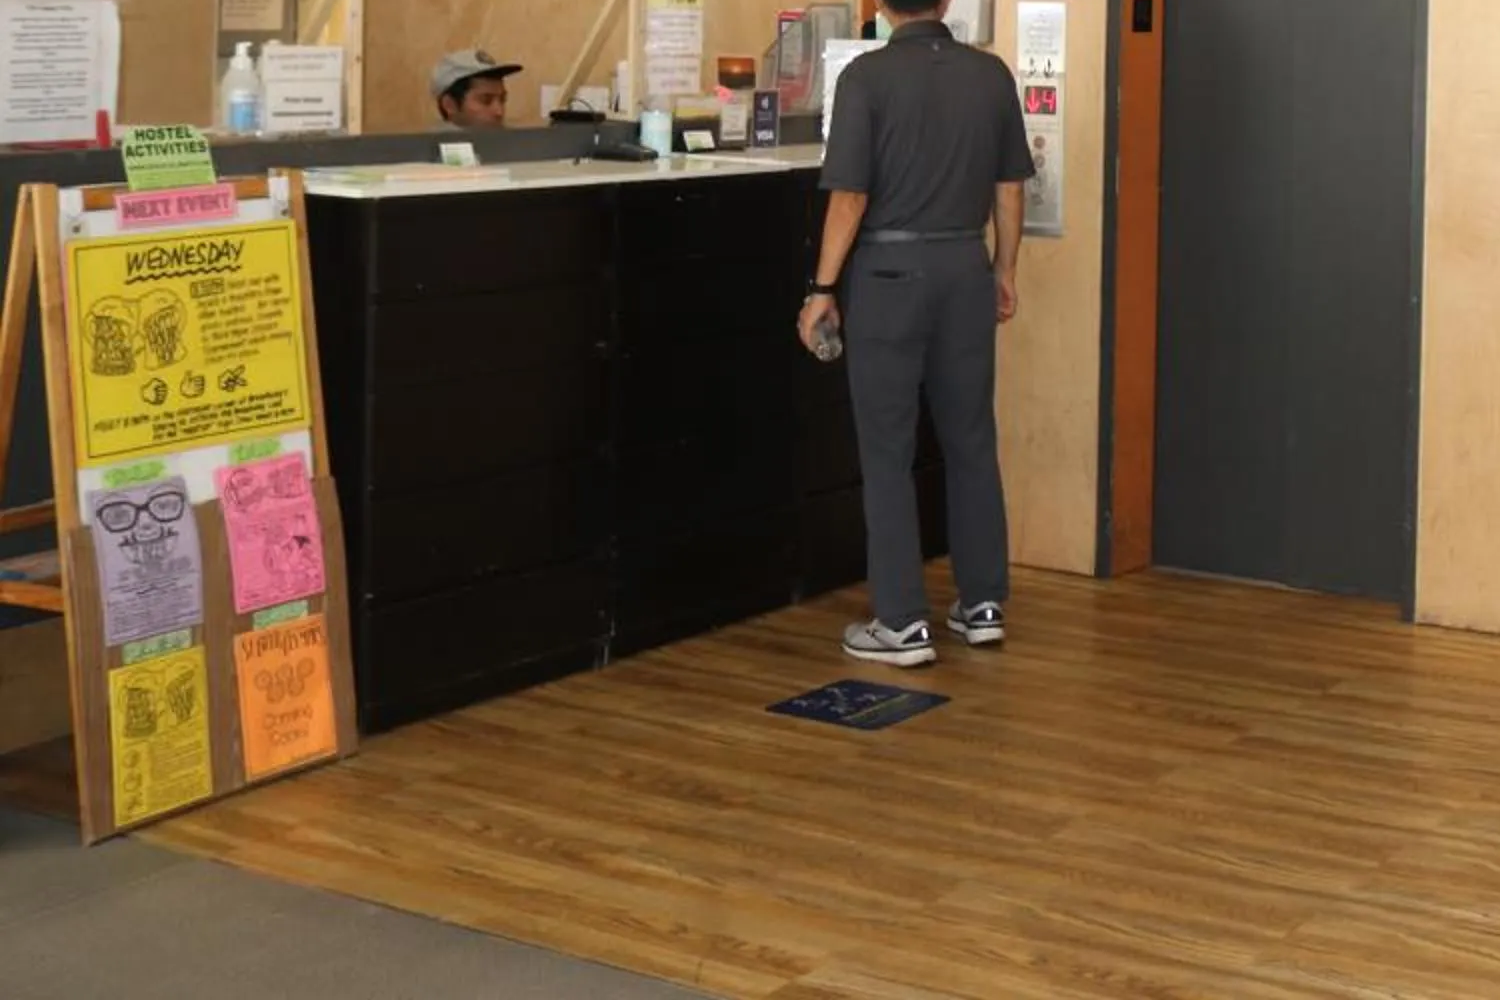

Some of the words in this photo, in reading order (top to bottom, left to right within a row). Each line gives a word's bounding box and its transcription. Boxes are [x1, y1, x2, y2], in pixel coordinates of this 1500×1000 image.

[134, 125, 193, 141] HOSTEL
[125, 140, 208, 158] ACTIVITIES
[121, 198, 171, 219] NEXT
[176, 192, 230, 215] EVENT
[126, 239, 245, 275] WEDNESDAY
